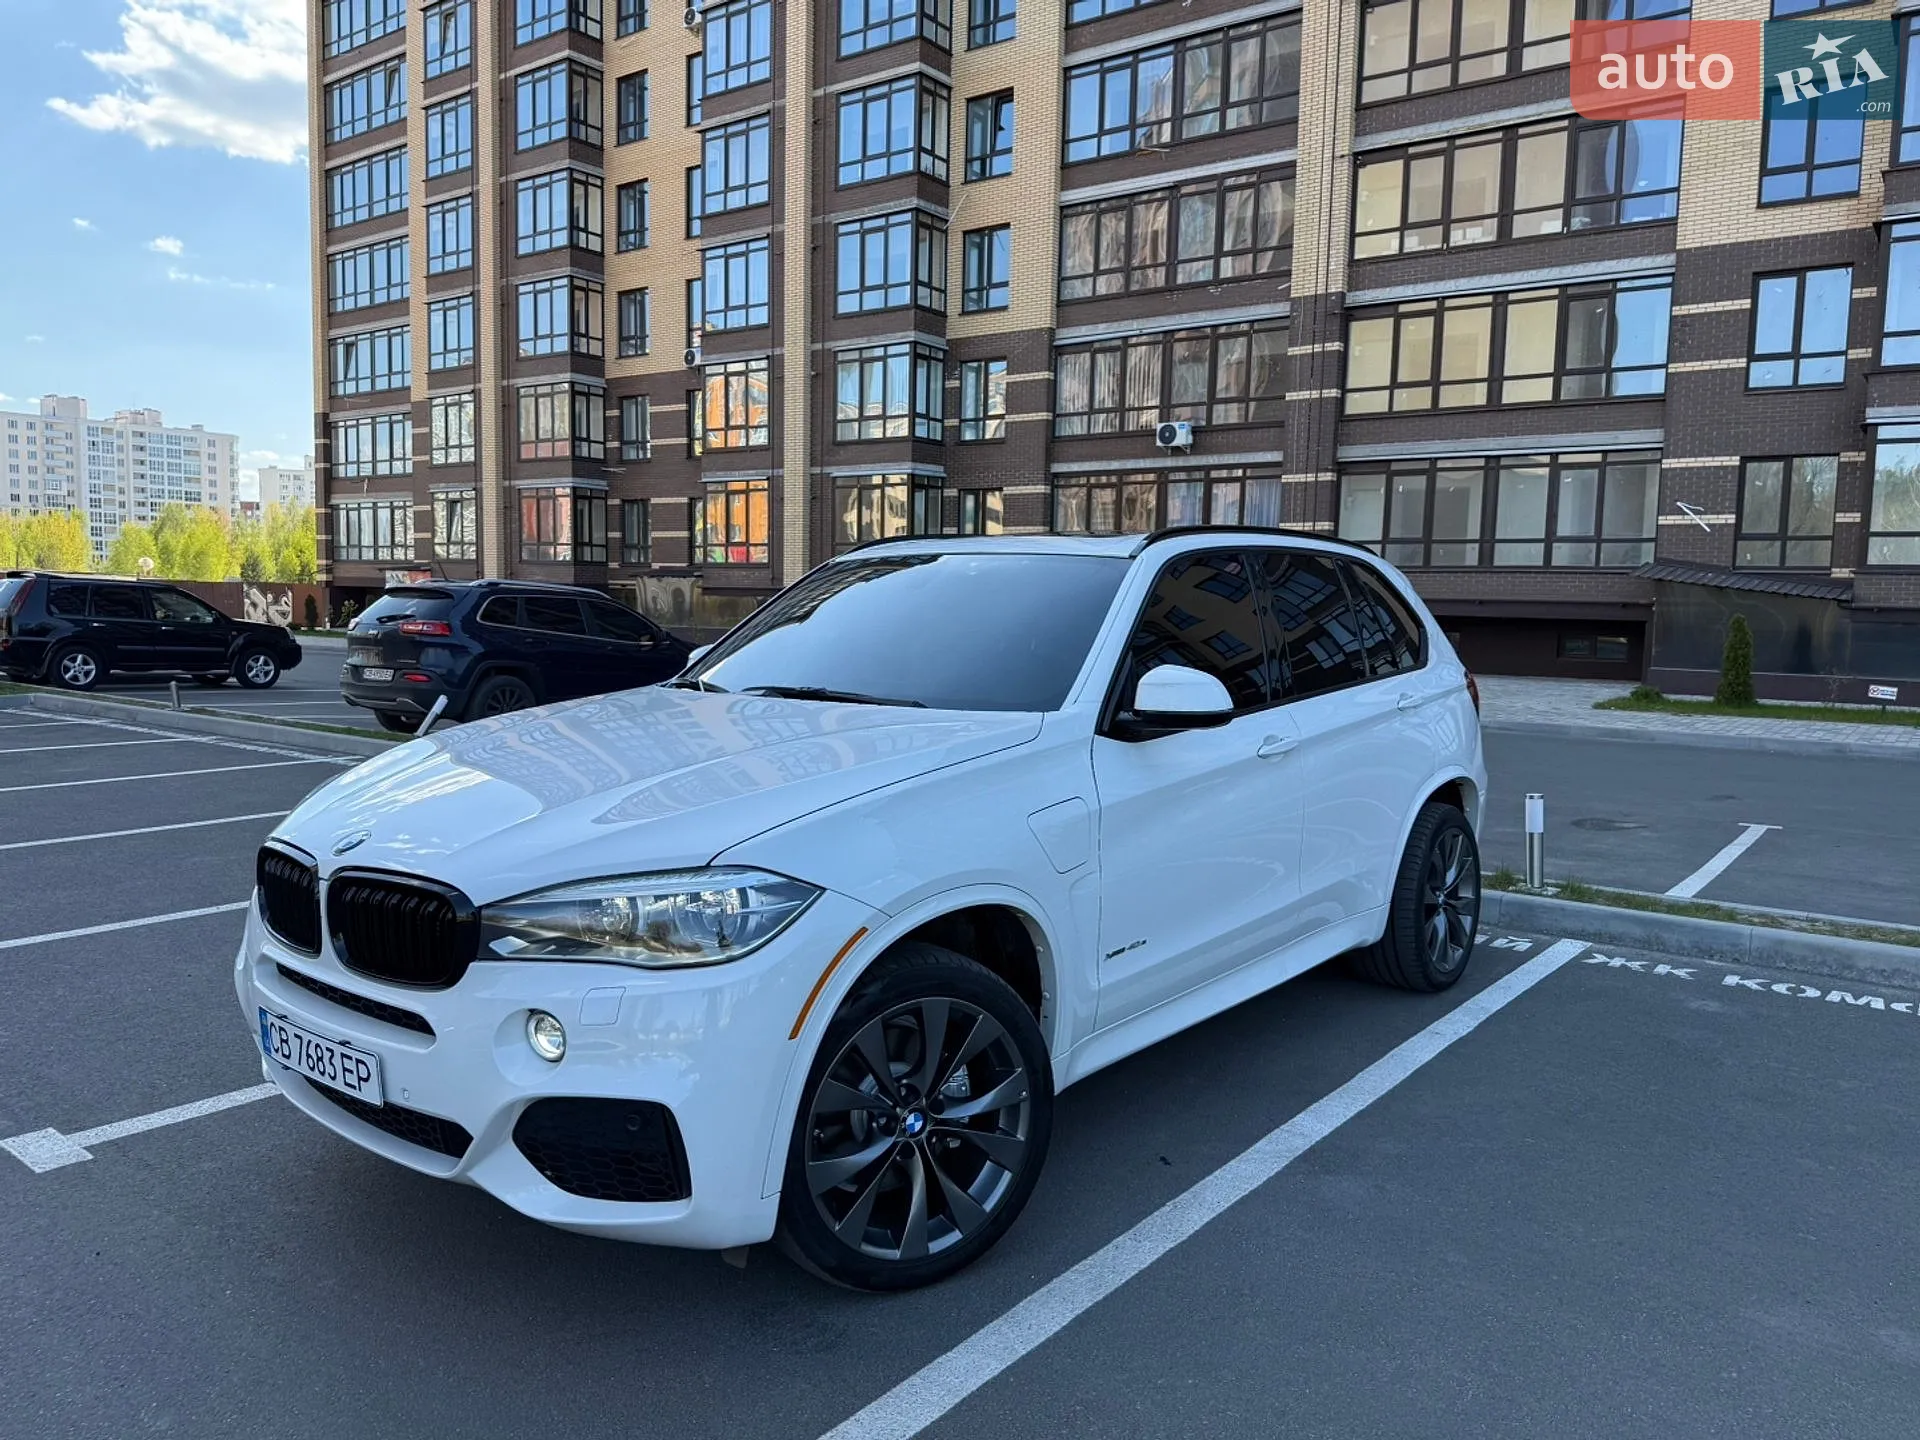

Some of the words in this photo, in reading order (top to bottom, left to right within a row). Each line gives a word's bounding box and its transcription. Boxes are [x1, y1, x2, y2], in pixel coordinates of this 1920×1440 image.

[269, 1021, 292, 1060] CB
[293, 1032, 338, 1081] 7683
[340, 1051, 371, 1092] EP
